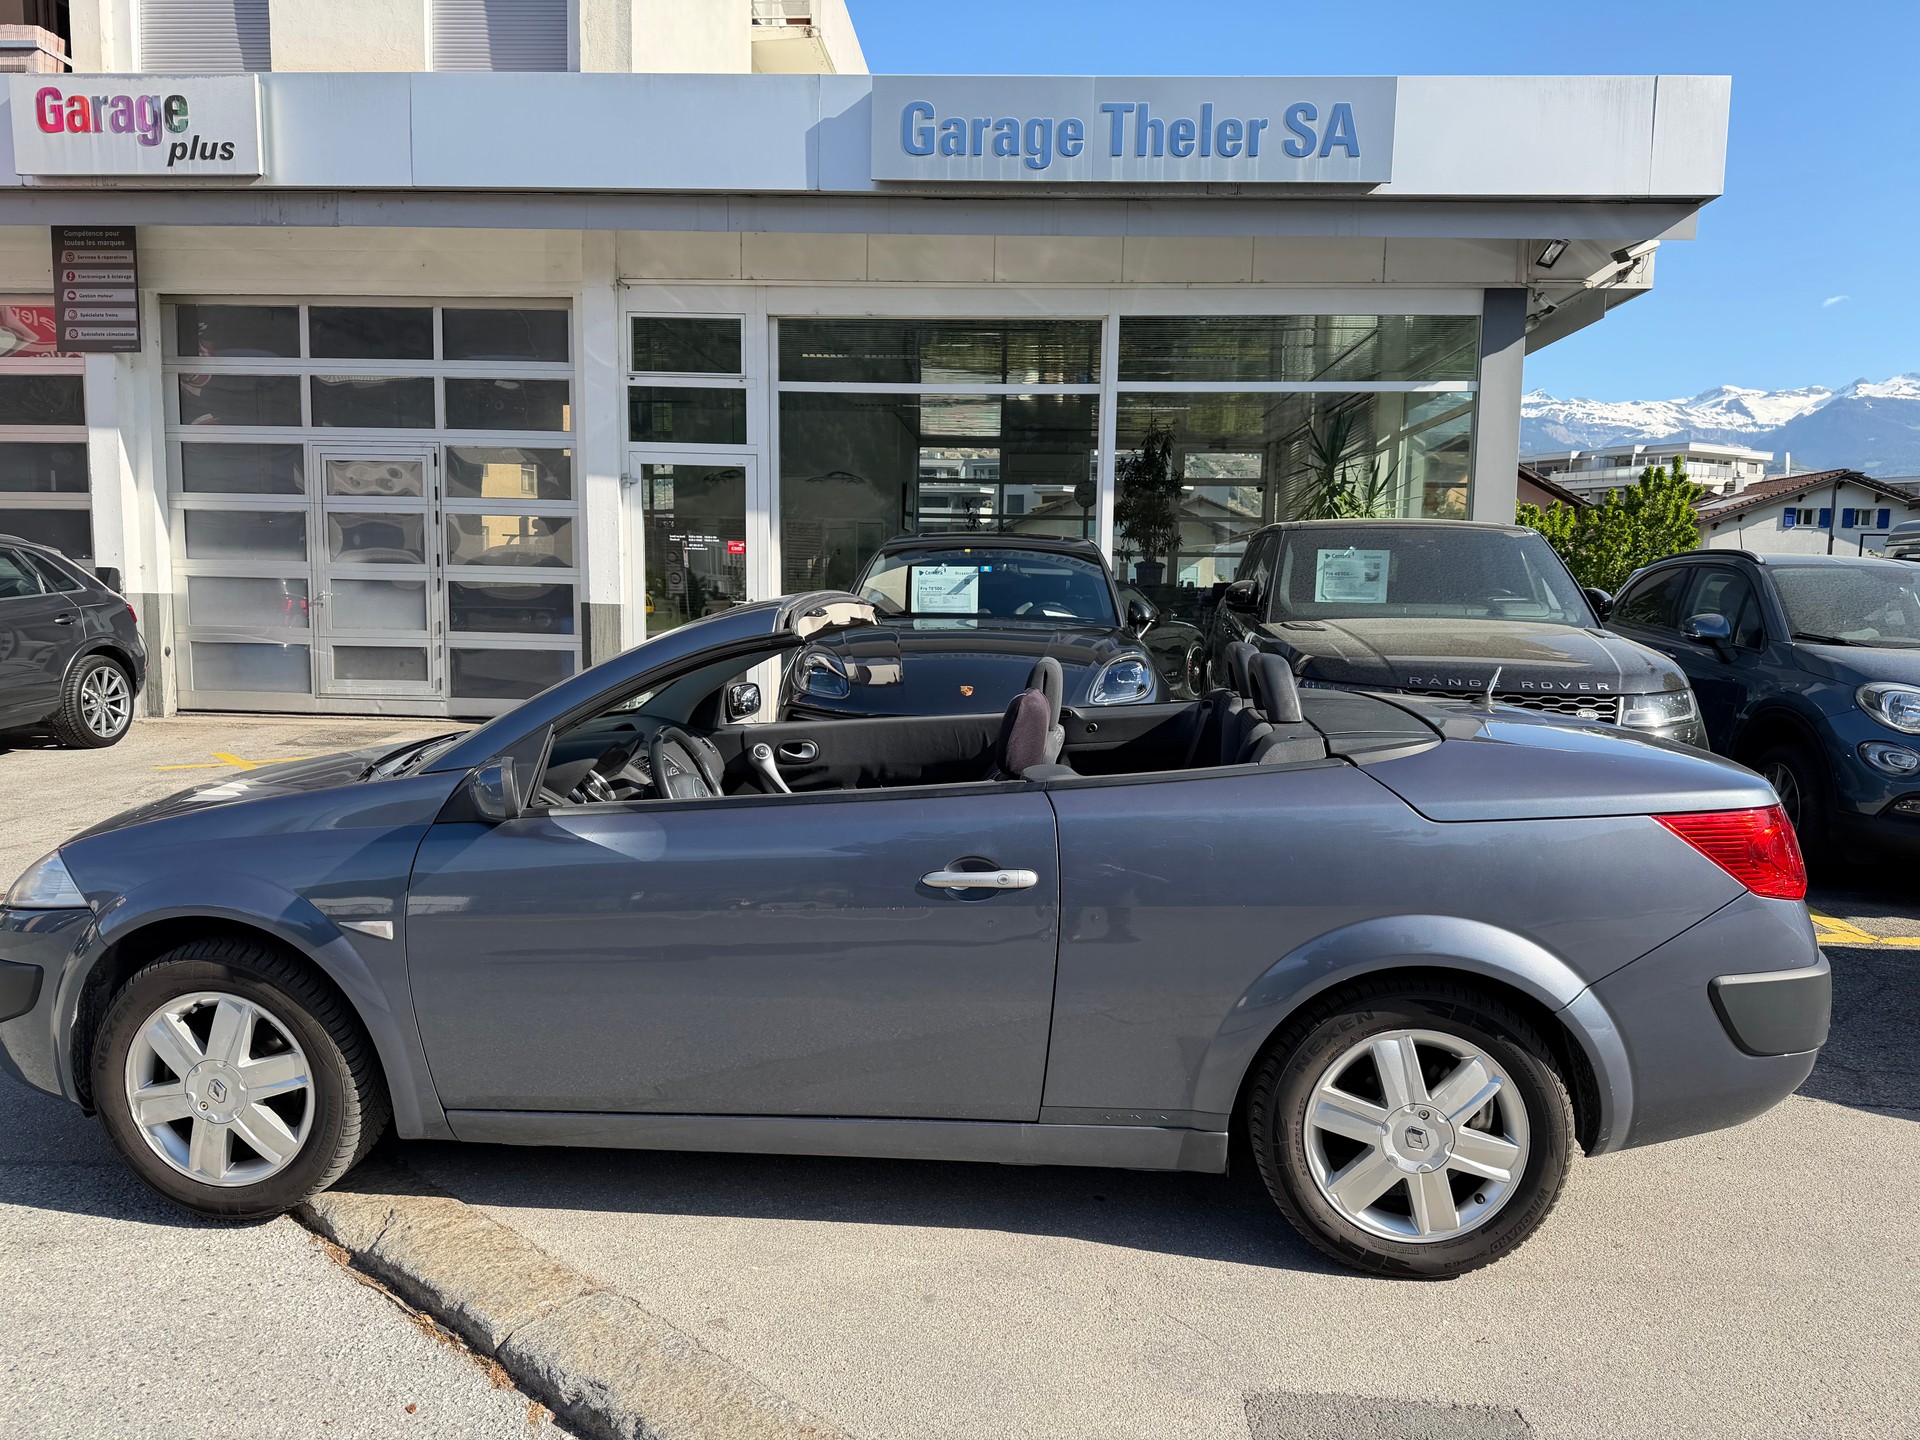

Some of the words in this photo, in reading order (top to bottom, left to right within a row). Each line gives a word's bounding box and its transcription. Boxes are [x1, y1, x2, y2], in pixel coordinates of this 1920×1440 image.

[36, 87, 189, 146] Garage
[901, 99, 1085, 170] Garage
[1102, 101, 1269, 157] Theler
[1283, 101, 1361, 158] SA
[167, 135, 236, 167] plus
[64, 230, 104, 238] Compétence
[1408, 675, 1500, 688] RANGE
[1521, 680, 1610, 691] ROVER
[97, 994, 137, 1072] NEXEN
[1294, 1009, 1375, 1074] NEXEN
